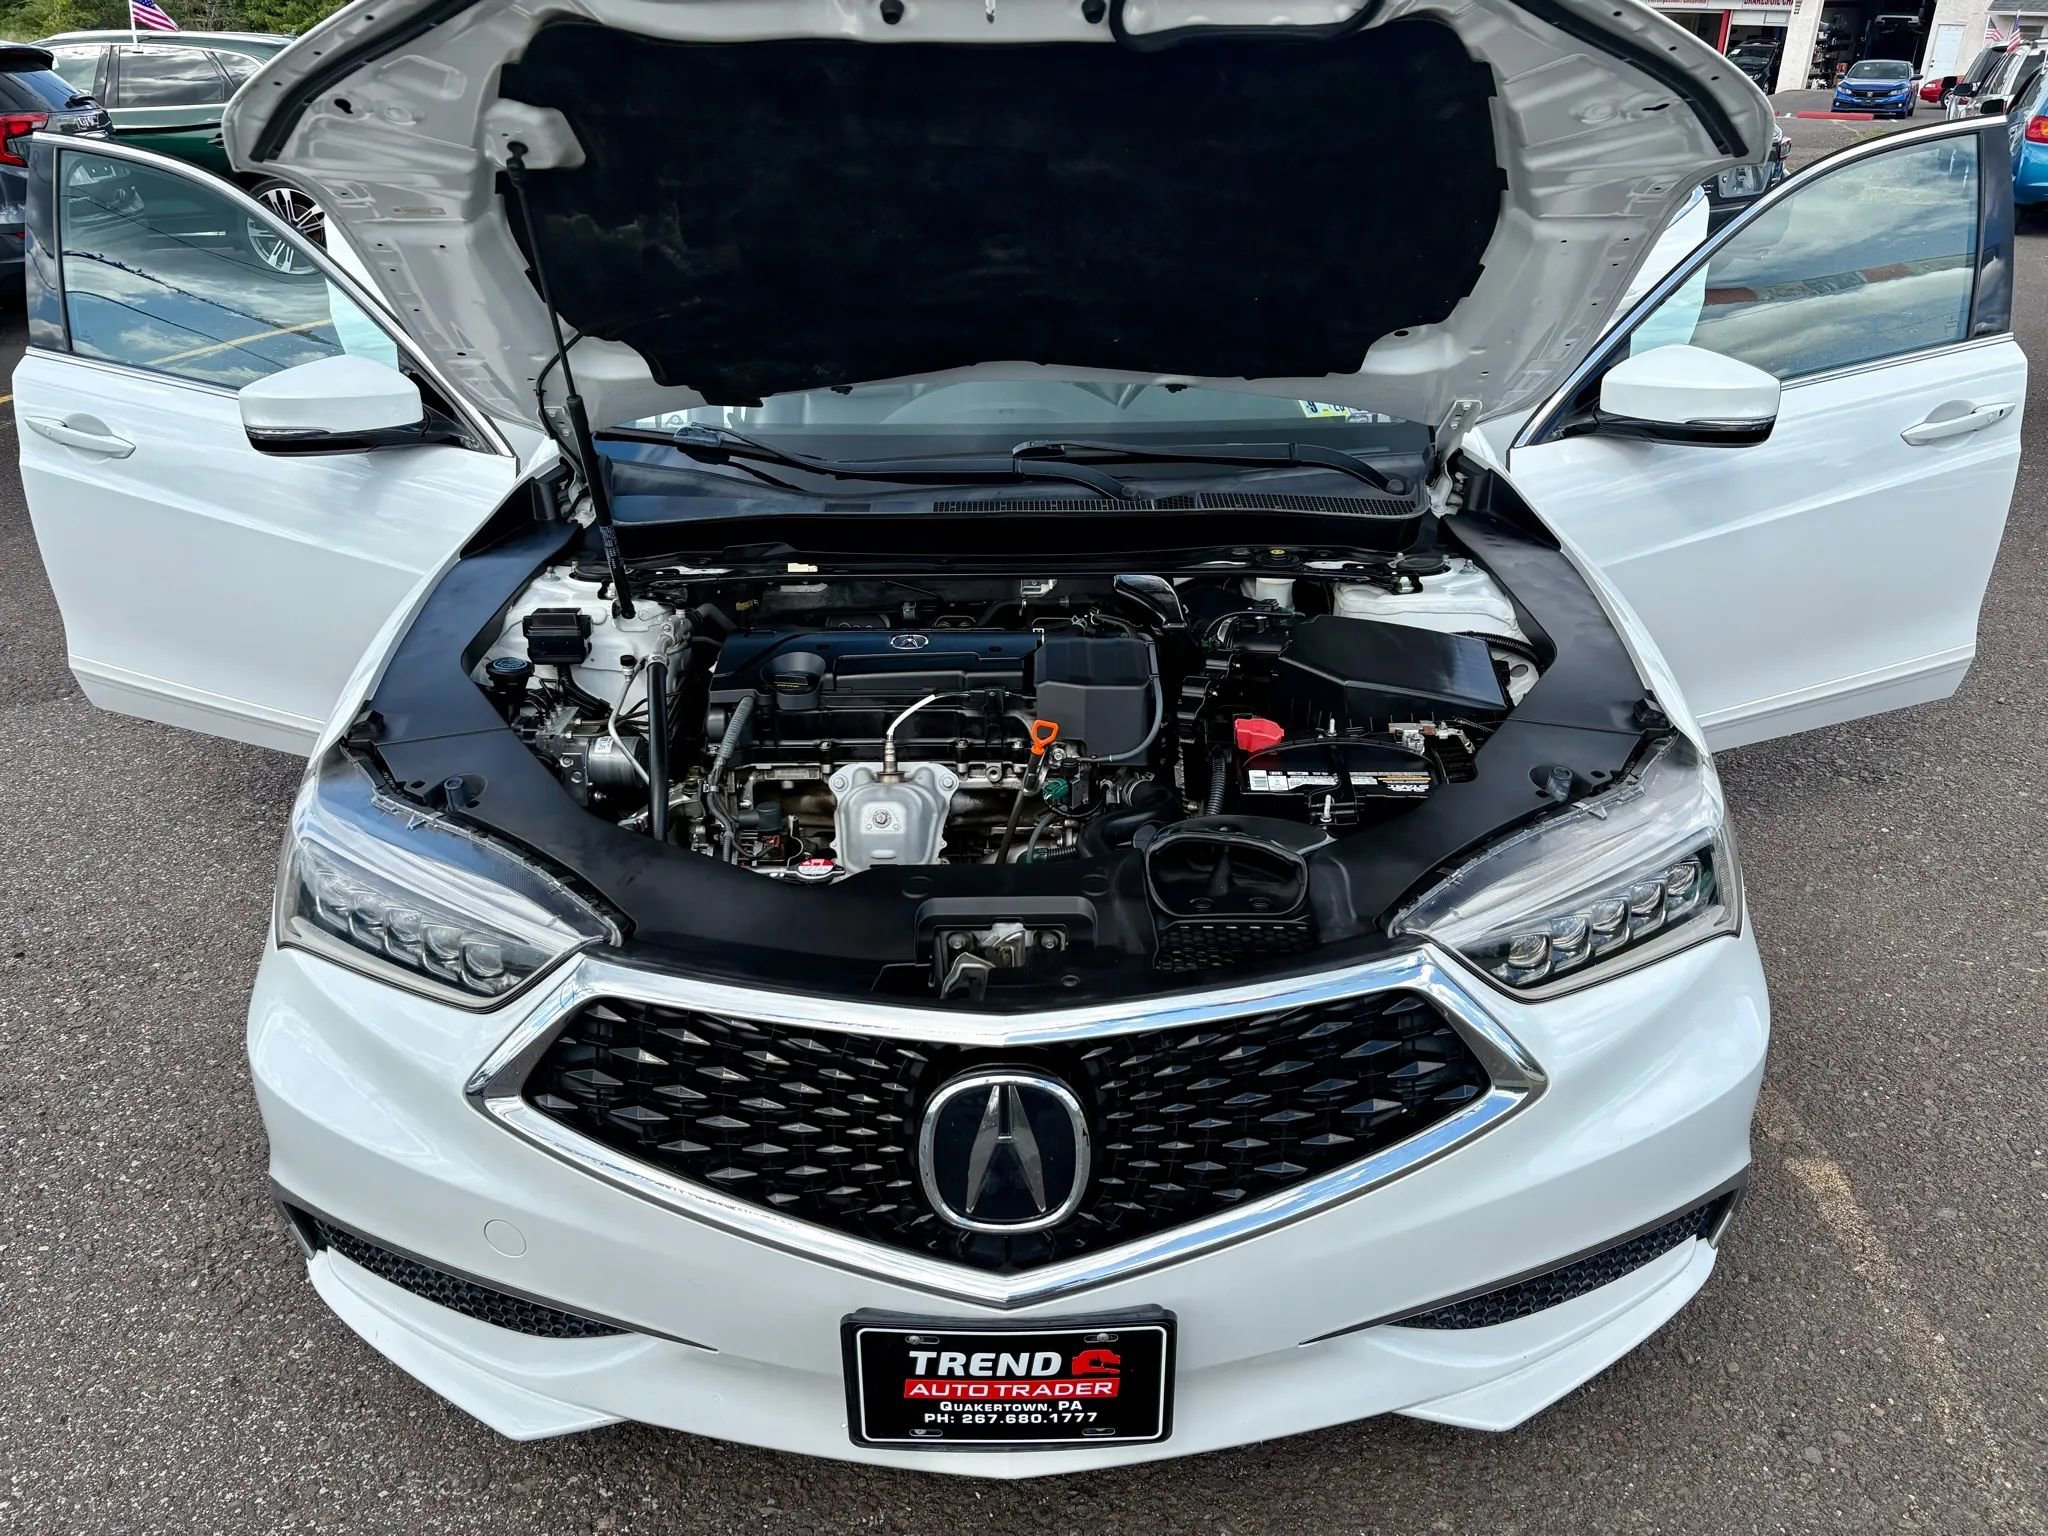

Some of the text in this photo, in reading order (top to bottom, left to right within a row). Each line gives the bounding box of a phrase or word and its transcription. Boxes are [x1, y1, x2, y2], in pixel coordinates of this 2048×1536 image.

[909, 1351, 1062, 1377] TREND
[909, 1382, 1113, 1397] AUTO TRADER
[1058, 1400, 1083, 1411] PA
[924, 1412, 1098, 1425] PH: 267.680.1777
